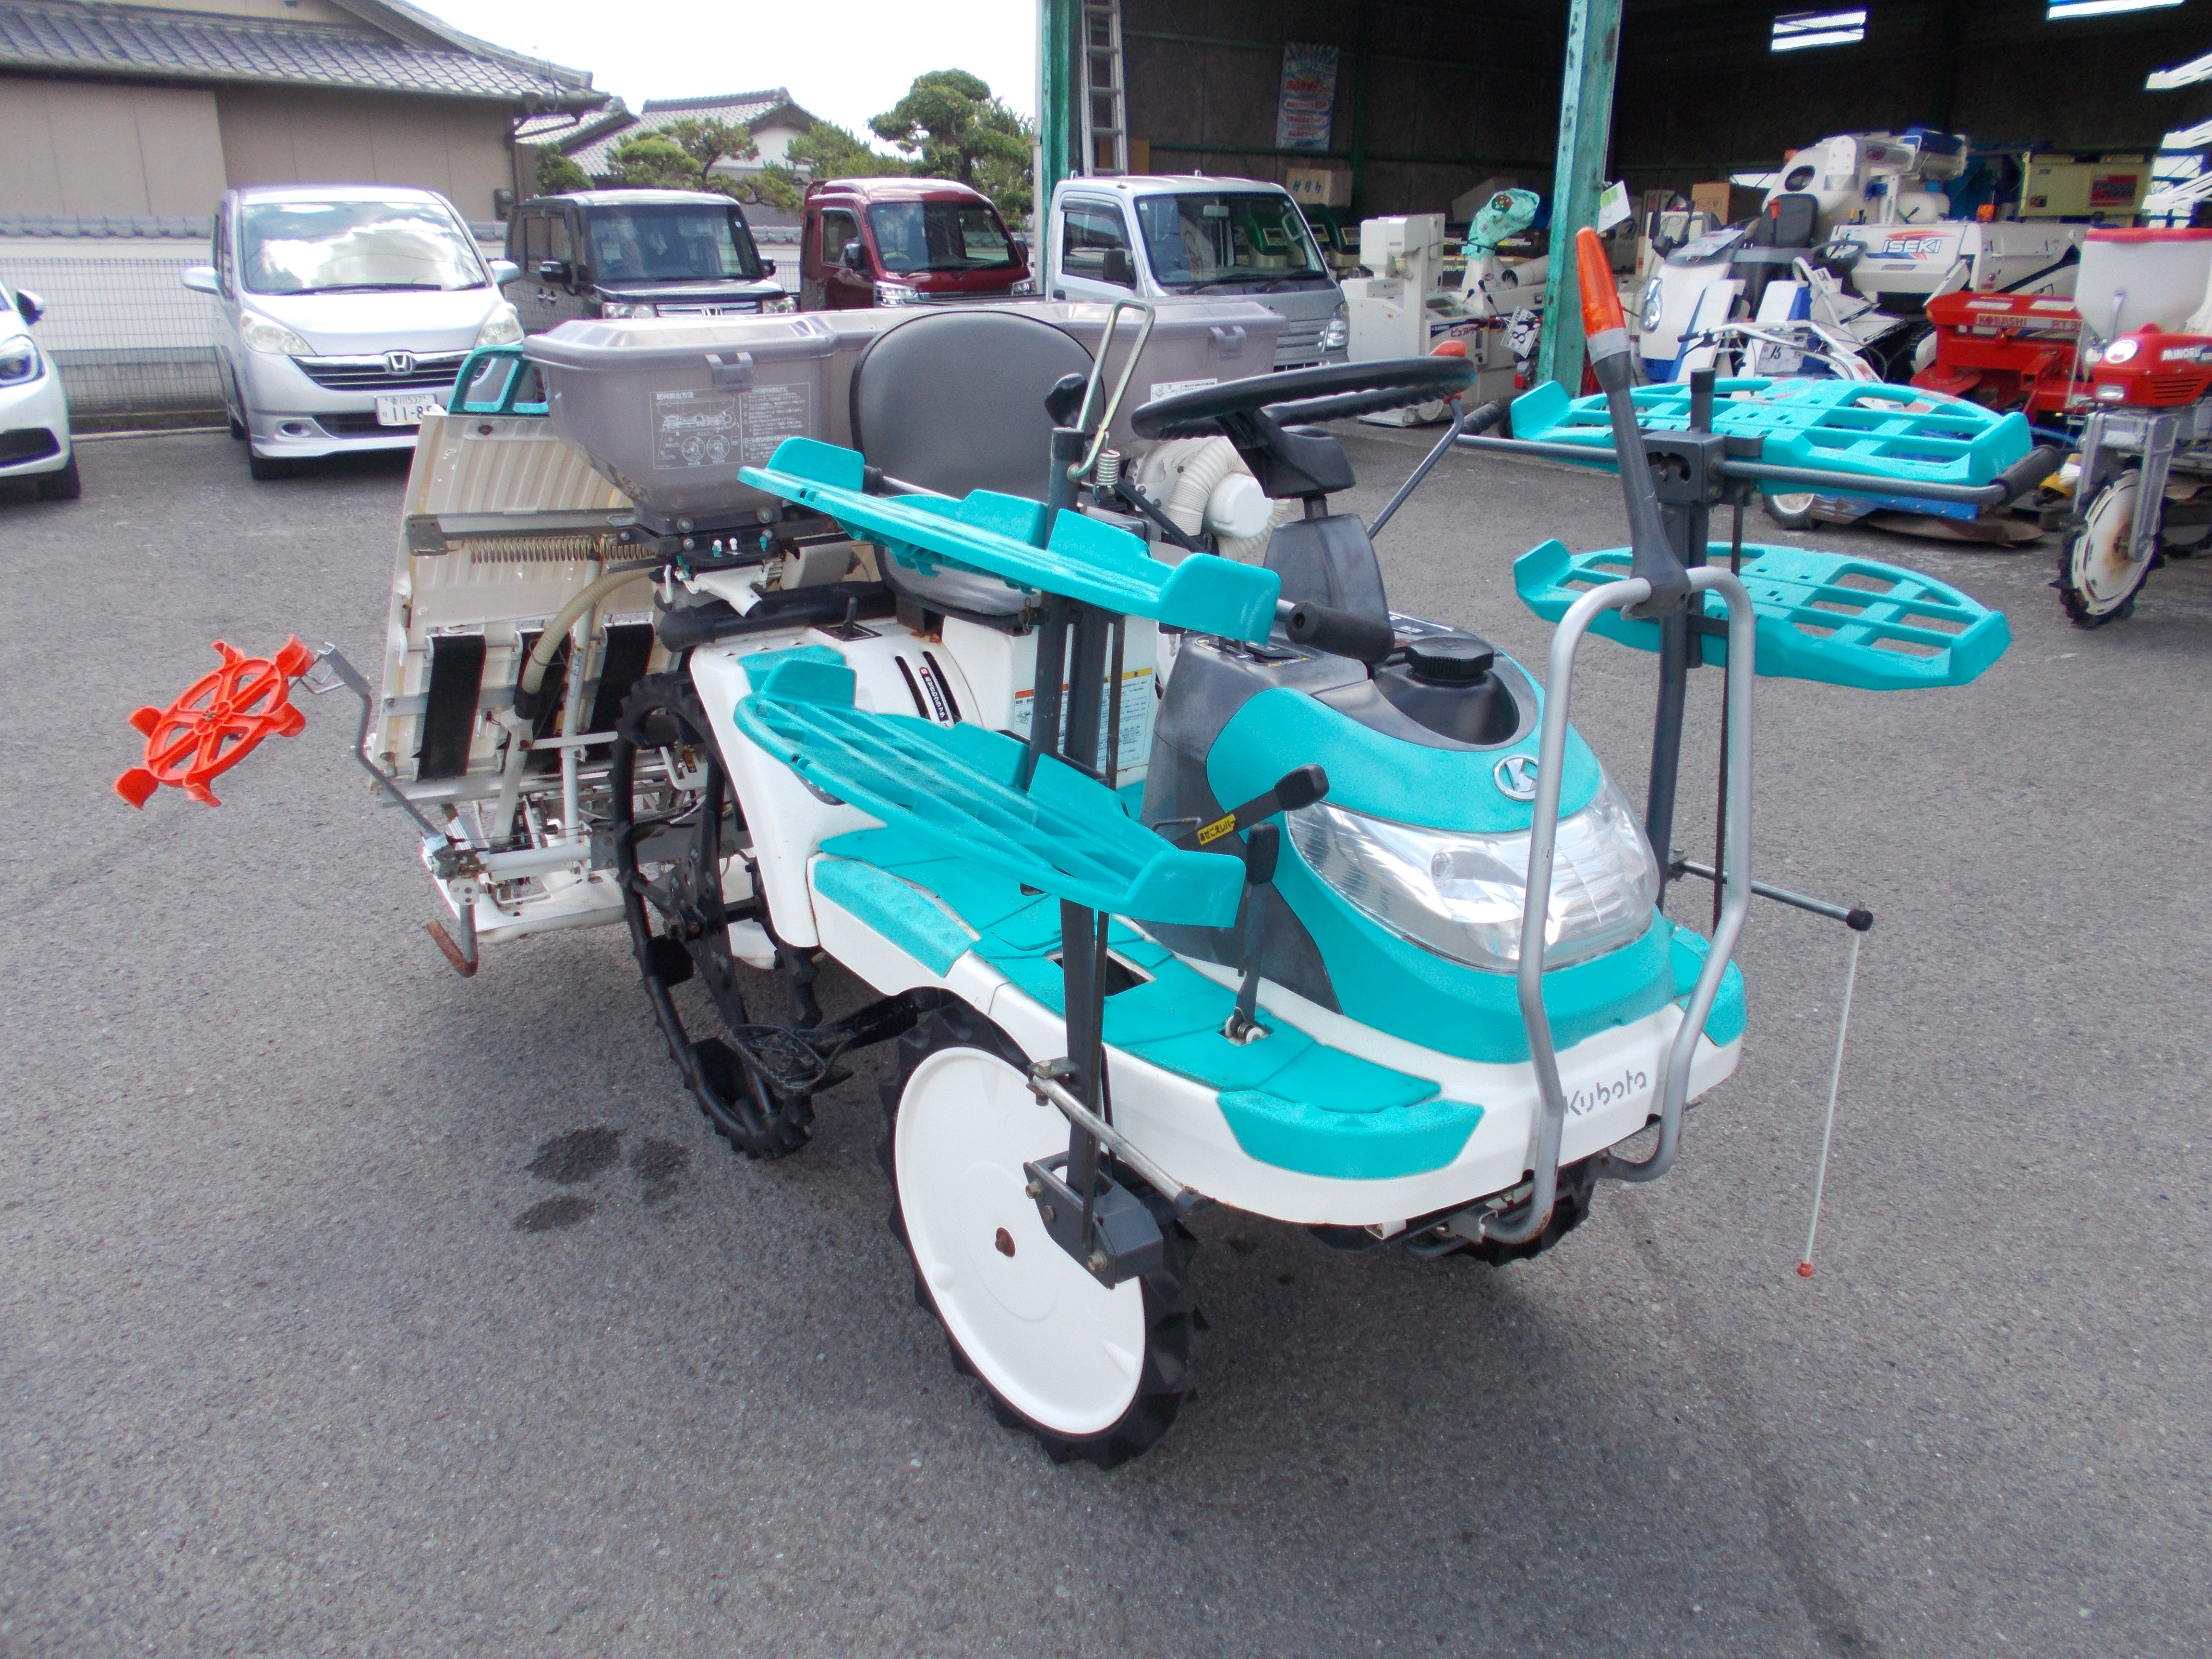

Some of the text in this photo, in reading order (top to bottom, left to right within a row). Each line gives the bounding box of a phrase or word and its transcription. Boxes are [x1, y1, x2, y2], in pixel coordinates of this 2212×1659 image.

[1882, 239, 1942, 253] ISEKI
[1978, 315, 2027, 328] KOBASHI
[393, 405, 432, 421] 11-8
[1563, 1069, 1647, 1117] Kubota
